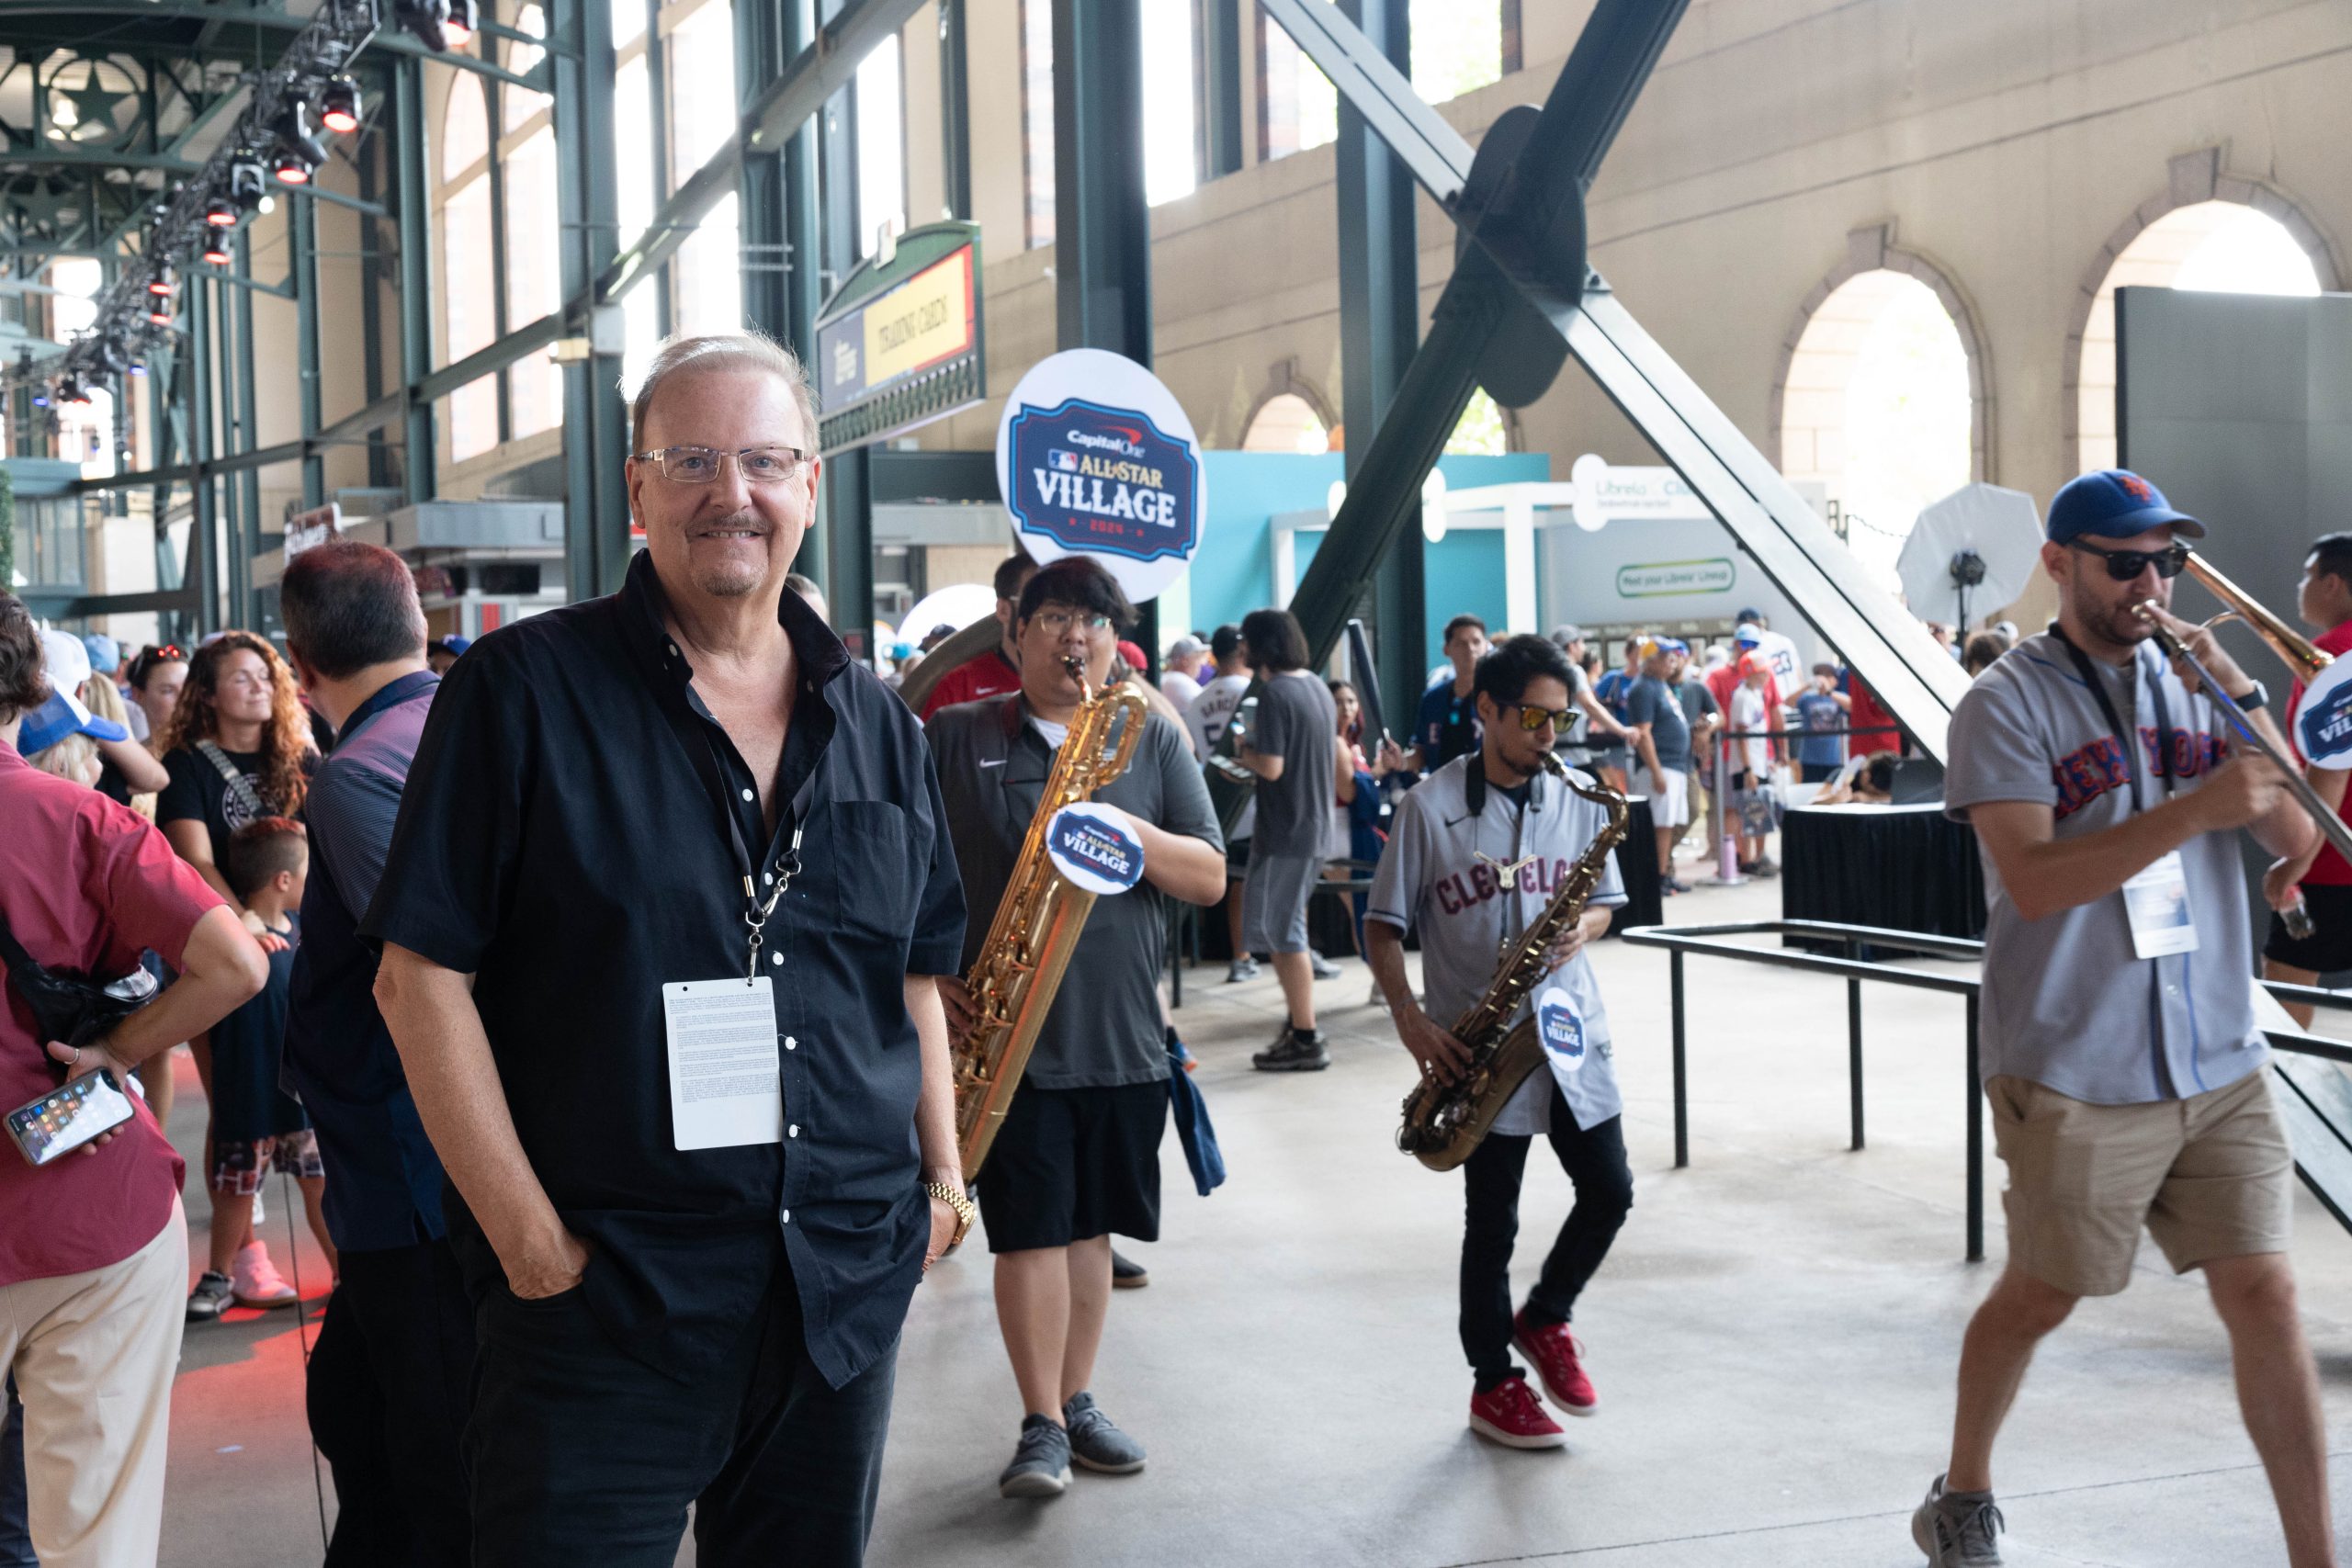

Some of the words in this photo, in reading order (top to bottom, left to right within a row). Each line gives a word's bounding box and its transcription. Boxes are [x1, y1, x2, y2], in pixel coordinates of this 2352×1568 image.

[1034, 468, 1176, 528] VILLAGE
[1064, 832, 1130, 874] VILLAGE
[1546, 1025, 1579, 1046] VILLAGE
